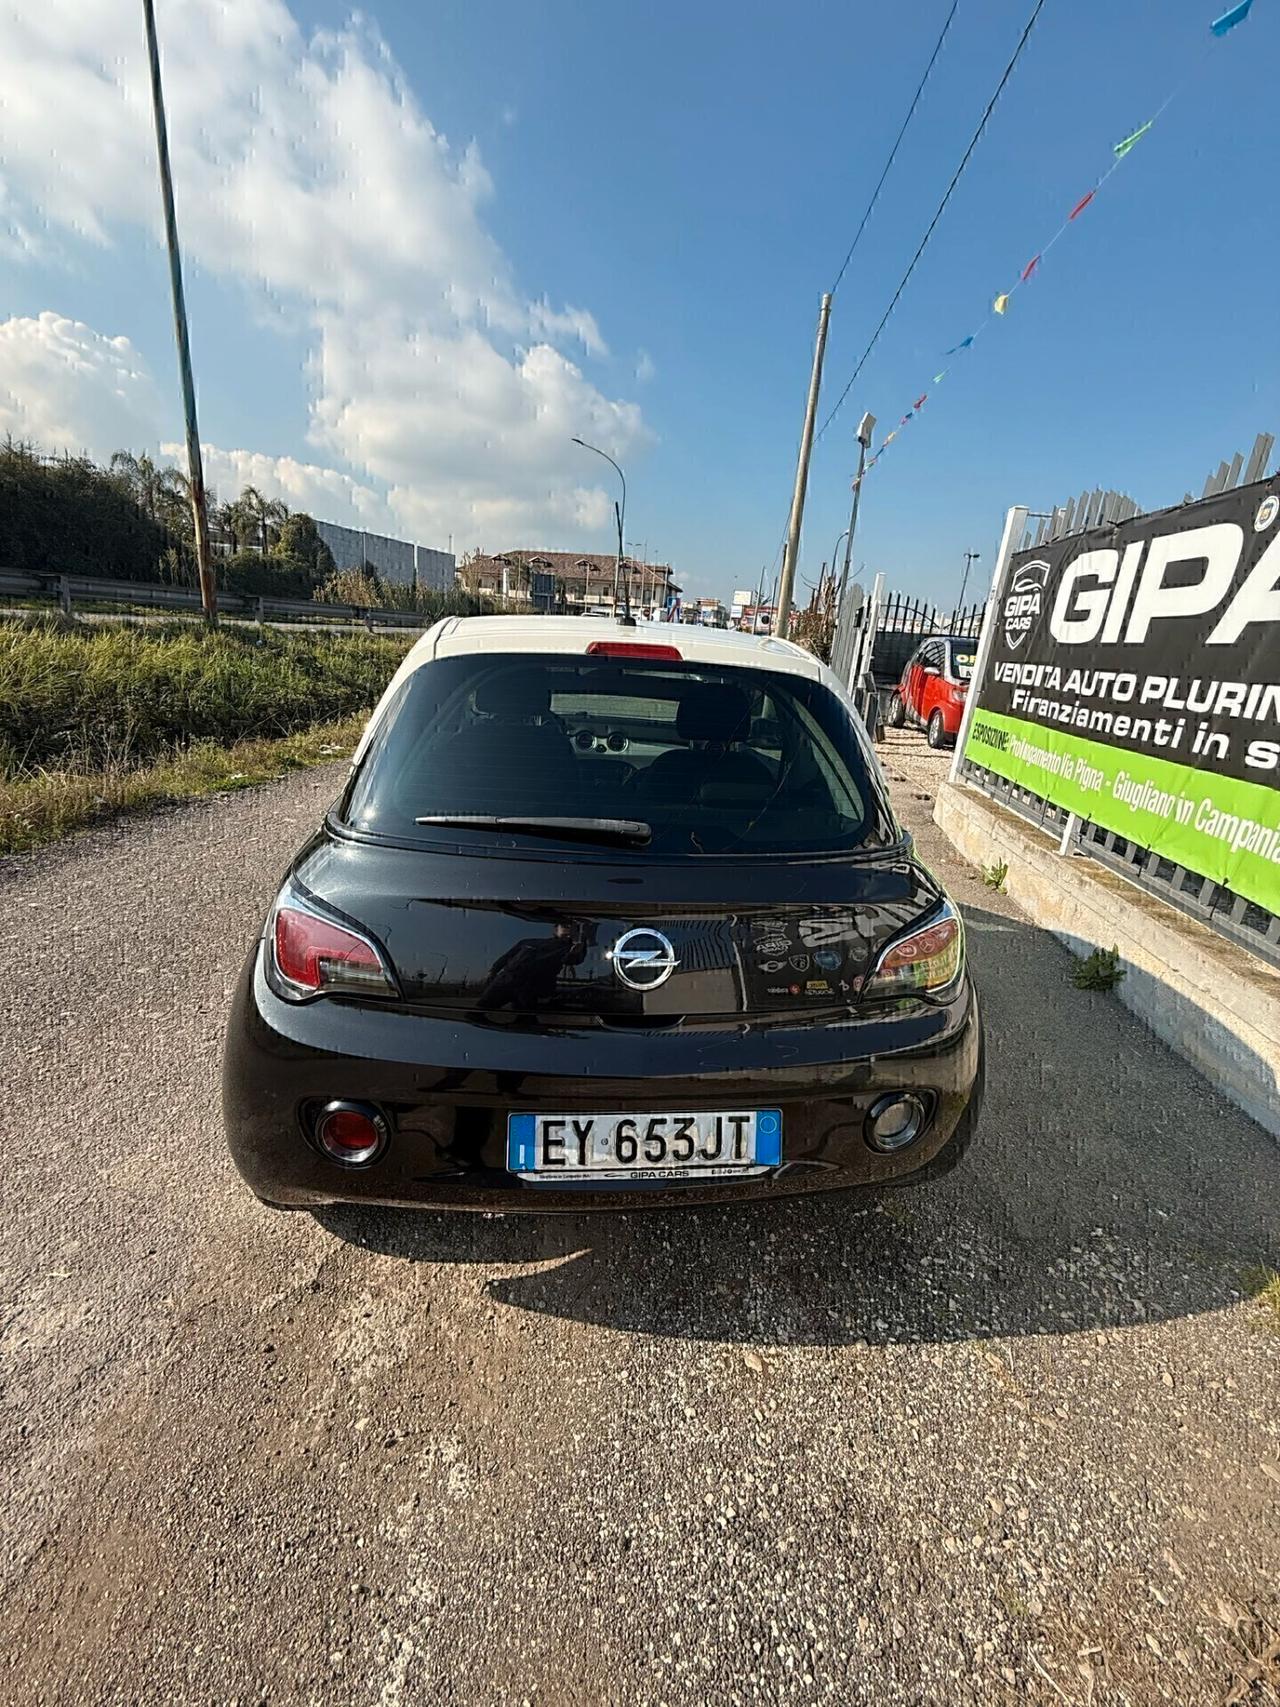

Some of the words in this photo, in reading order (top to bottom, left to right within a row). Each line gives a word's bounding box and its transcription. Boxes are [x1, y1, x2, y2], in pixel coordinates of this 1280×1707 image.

[1004, 593, 1041, 618] GIPA
[1005, 616, 1032, 631] CARS
[994, 661, 1061, 691] VENDITA
[1062, 670, 1136, 702] AUTO
[1192, 717, 1230, 760] in
[1060, 751, 1076, 779] Via
[1075, 758, 1105, 792] Pigna
[1112, 770, 1176, 813] Giugliano
[1174, 792, 1197, 825] in
[542, 1119, 594, 1166] EY
[615, 1116, 751, 1164] 653JT
[630, 1171, 656, 1179] GIPA
[658, 1170, 689, 1179] CARS
